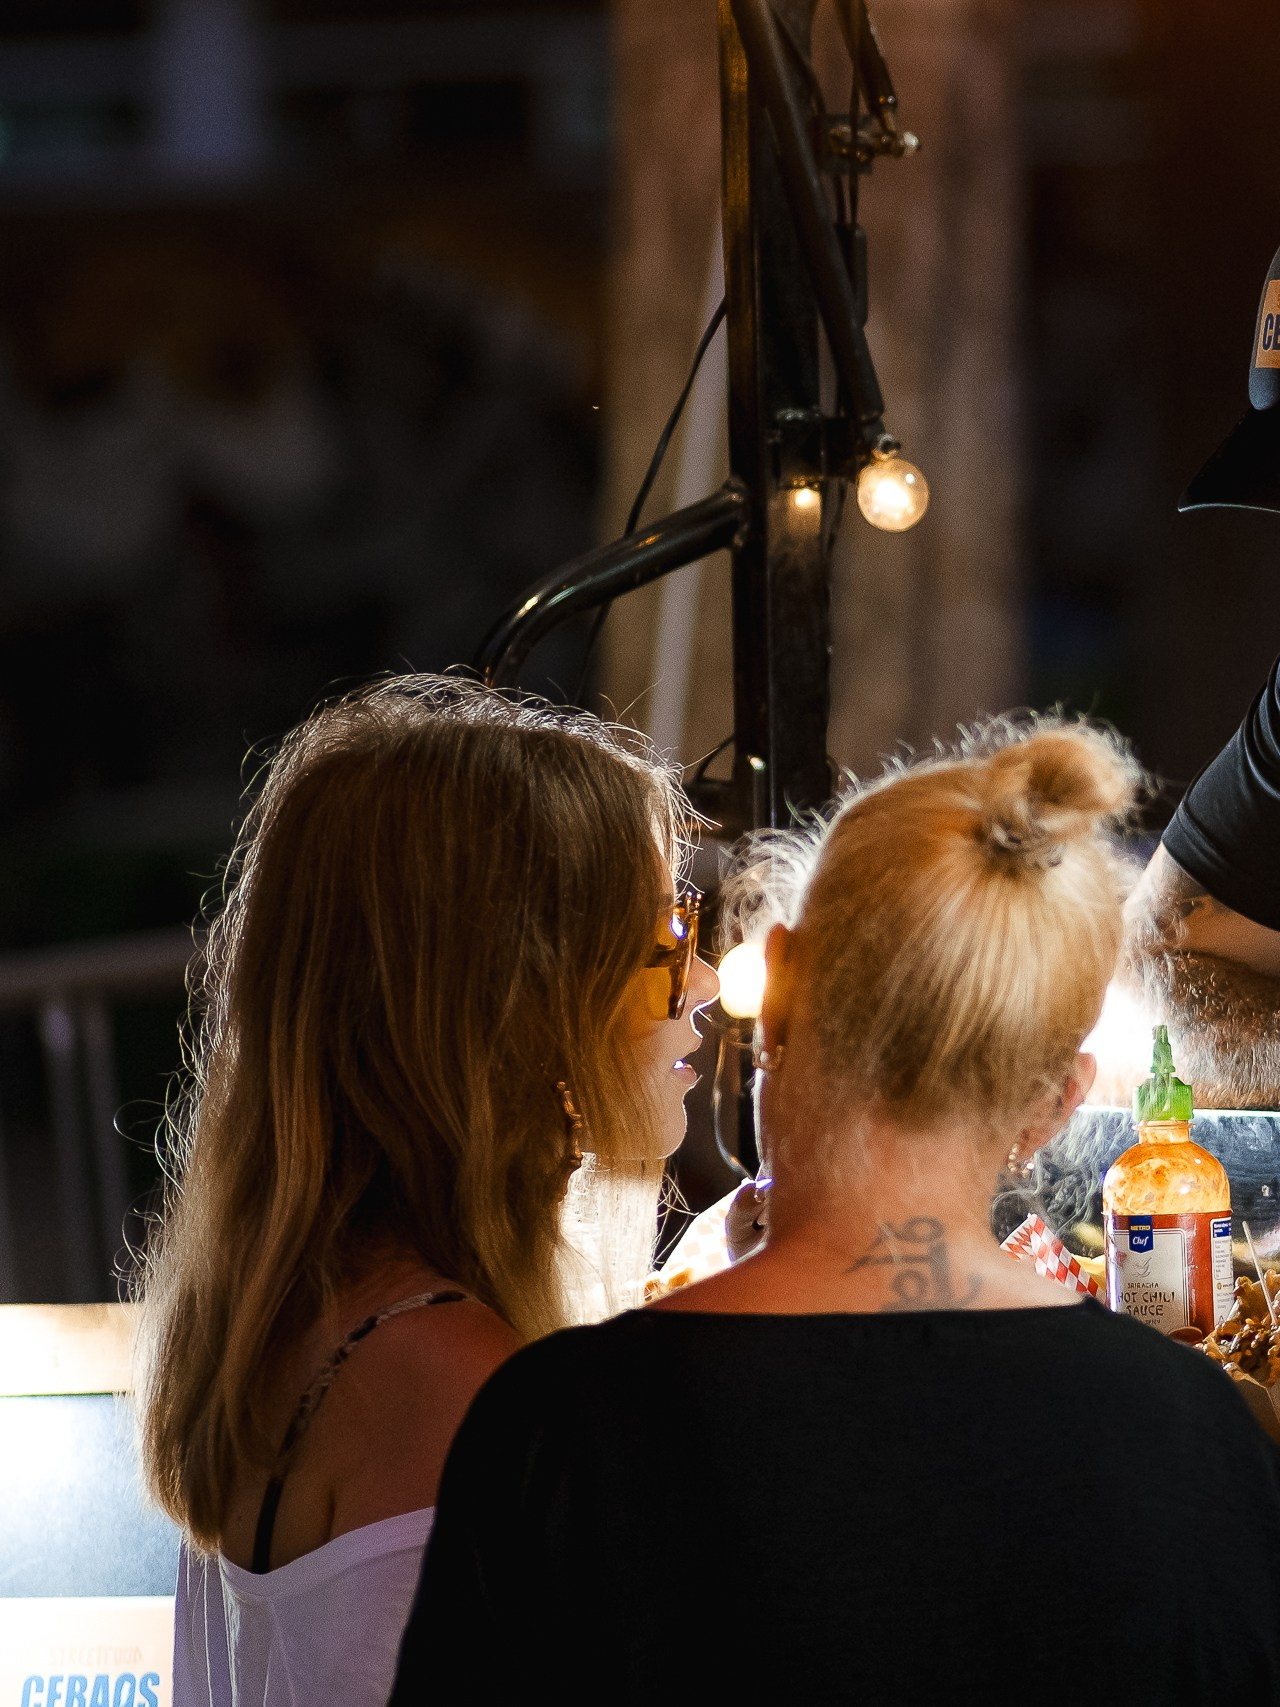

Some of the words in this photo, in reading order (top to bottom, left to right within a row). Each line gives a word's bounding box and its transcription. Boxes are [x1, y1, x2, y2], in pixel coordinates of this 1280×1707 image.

[1142, 1291, 1175, 1303] CHILI
[1126, 1304, 1164, 1316] SAUCE
[20, 1671, 161, 1707] CEBAOS
